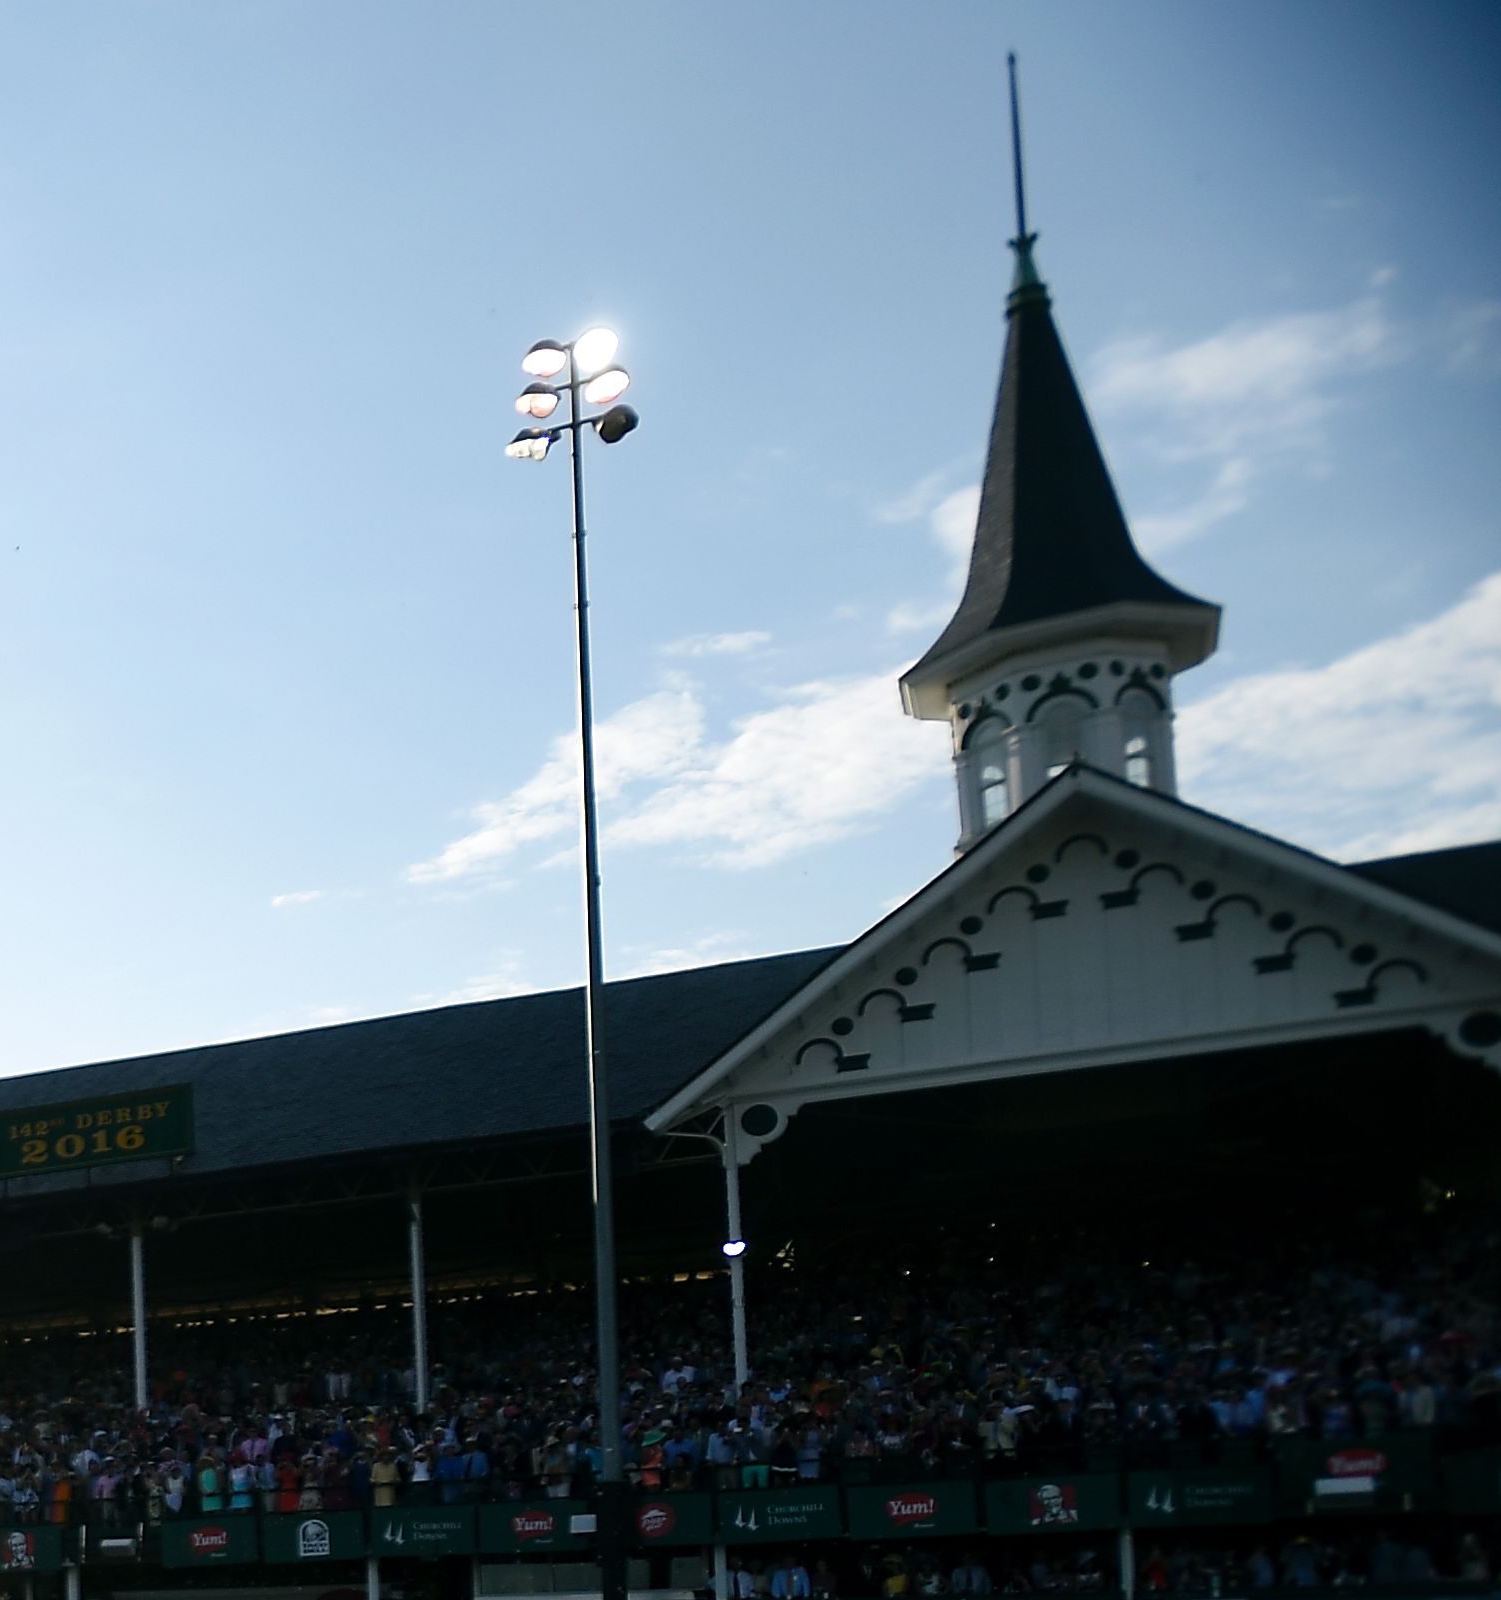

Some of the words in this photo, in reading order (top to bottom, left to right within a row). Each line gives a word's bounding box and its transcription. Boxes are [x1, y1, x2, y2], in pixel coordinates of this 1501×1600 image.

[76, 1101, 170, 1129] DERBY
[22, 1125, 147, 1164] 2016
[889, 1498, 936, 1516] Yum!
[515, 1517, 553, 1532] Yum!
[193, 1532, 227, 1547] Yum!
